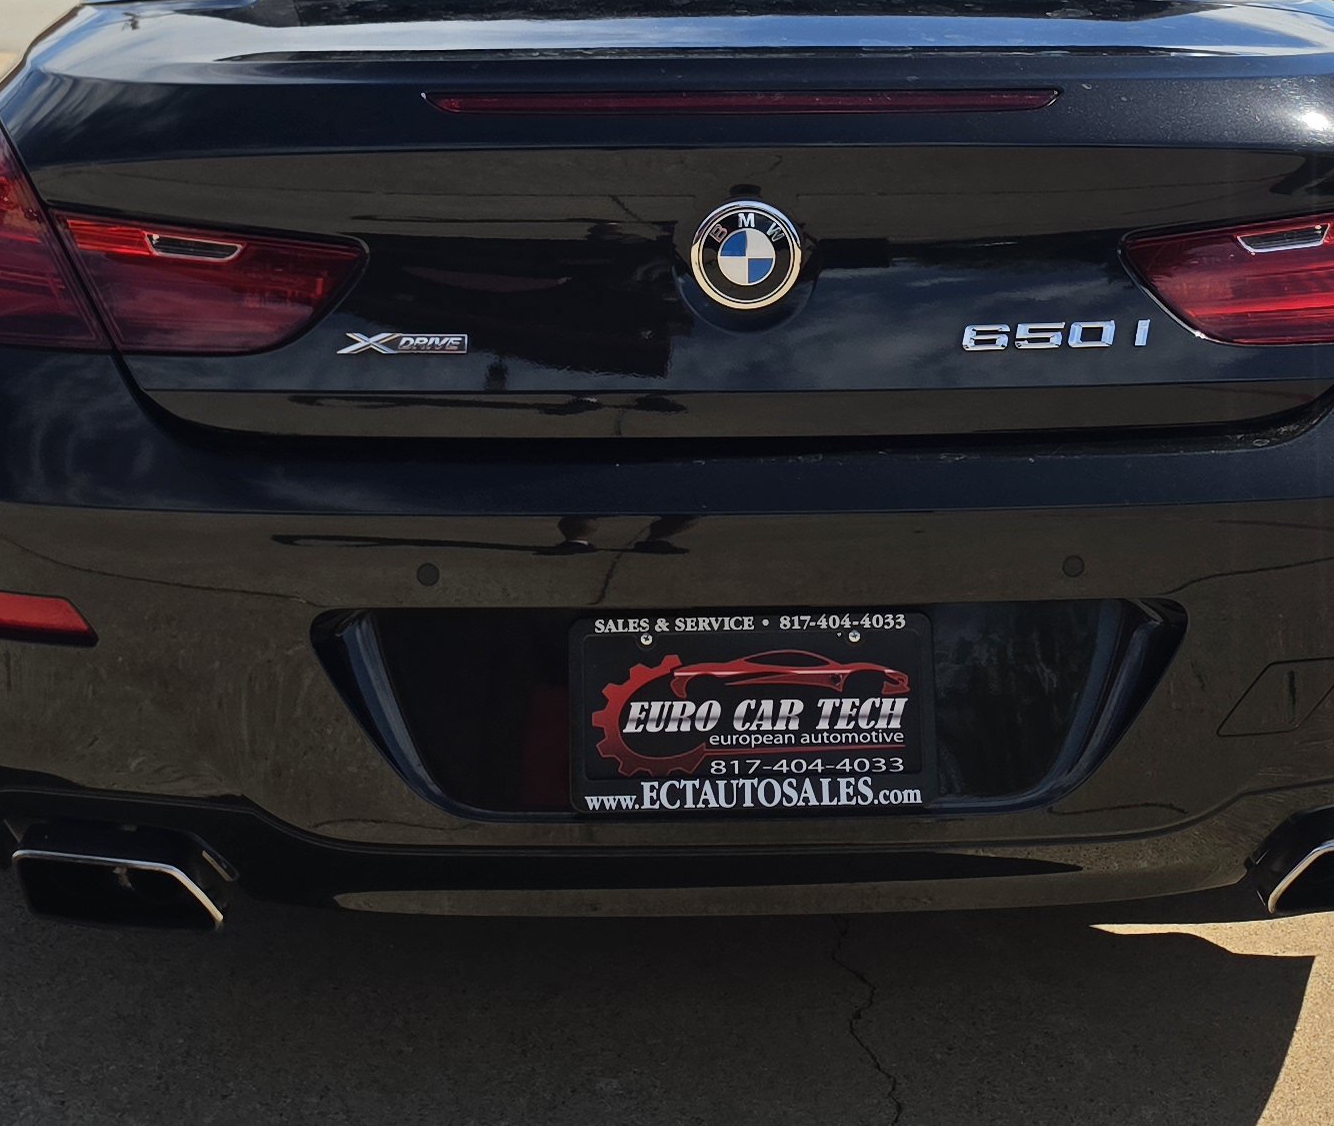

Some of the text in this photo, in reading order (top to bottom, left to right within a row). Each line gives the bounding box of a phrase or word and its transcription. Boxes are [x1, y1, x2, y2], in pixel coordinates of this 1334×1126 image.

[709, 212, 786, 244] BMW
[594, 613, 907, 634] SALES & SERVICE 817-404-4033
[622, 697, 909, 734] EURO CAR TECH
[708, 729, 905, 748] european automotive
[709, 757, 905, 775] 817-404-4033
[584, 777, 923, 812] www.ECTAUTOSALES.com
